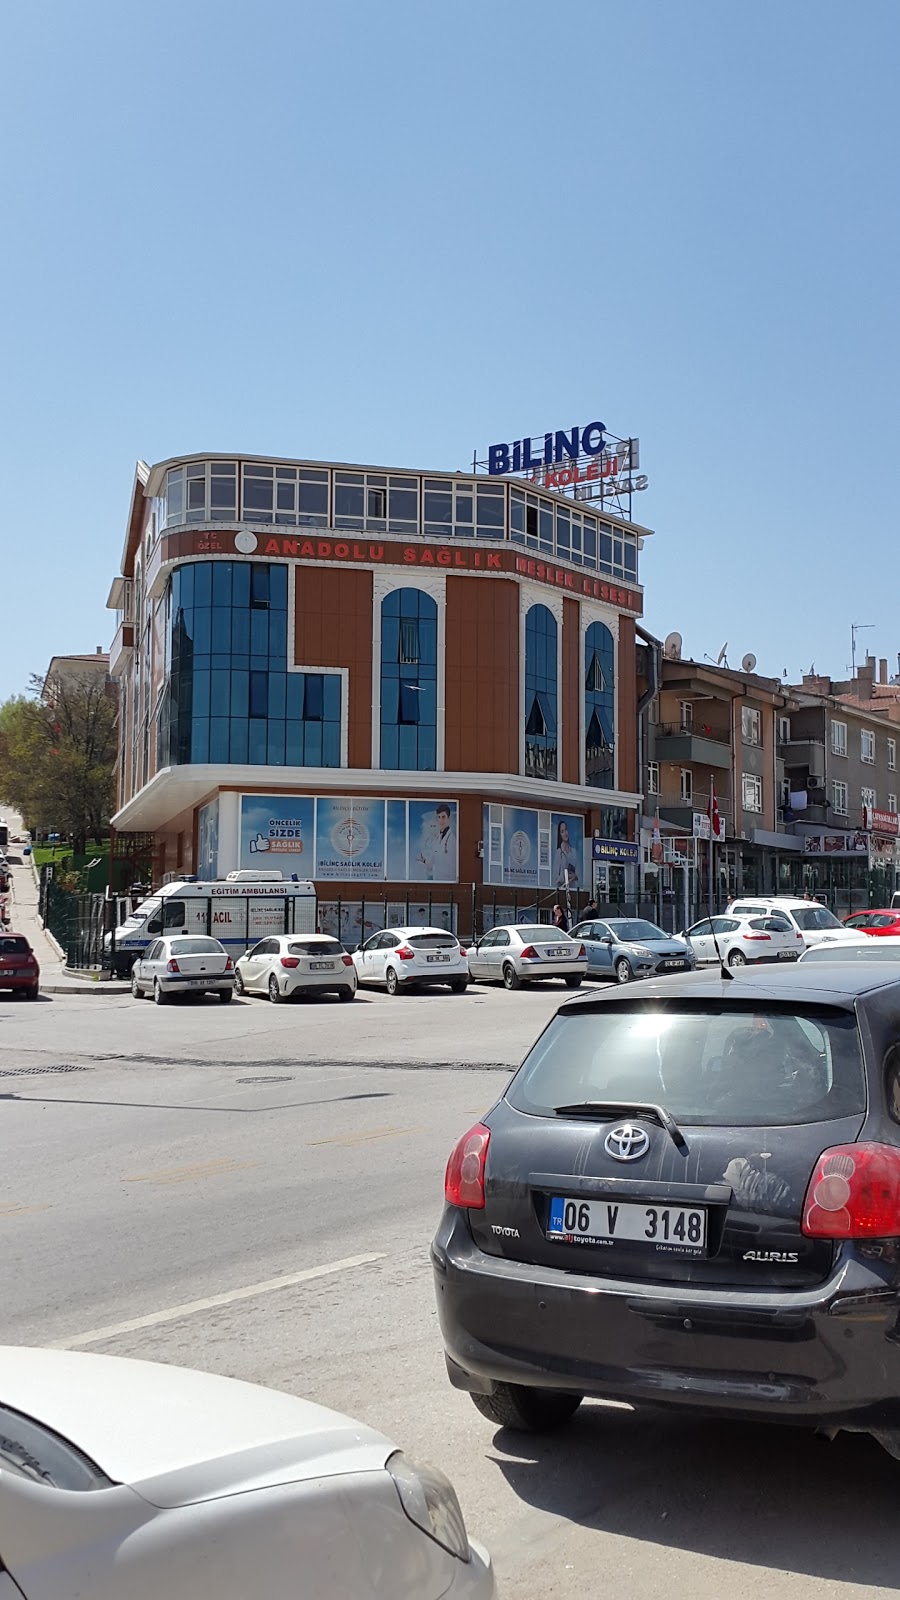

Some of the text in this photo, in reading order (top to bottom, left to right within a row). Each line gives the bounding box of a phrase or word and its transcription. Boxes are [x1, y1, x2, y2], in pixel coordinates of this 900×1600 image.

[198, 540, 223, 550] ÖZEL
[265, 538, 633, 607] ANADOLU SAĞLIK MESLEK LİSESİ
[269, 826, 301, 838] SİZDE
[271, 839, 301, 848] SAĞLIK
[600, 843, 618, 857] BİLİNÇ
[211, 887, 287, 895] EĞİTİM AMBULANSI
[552, 1216, 563, 1226] TR
[564, 1202, 701, 1243] 06 V 3148
[491, 1224, 520, 1238] TOYOTA
[742, 1250, 799, 1263] AURIS
